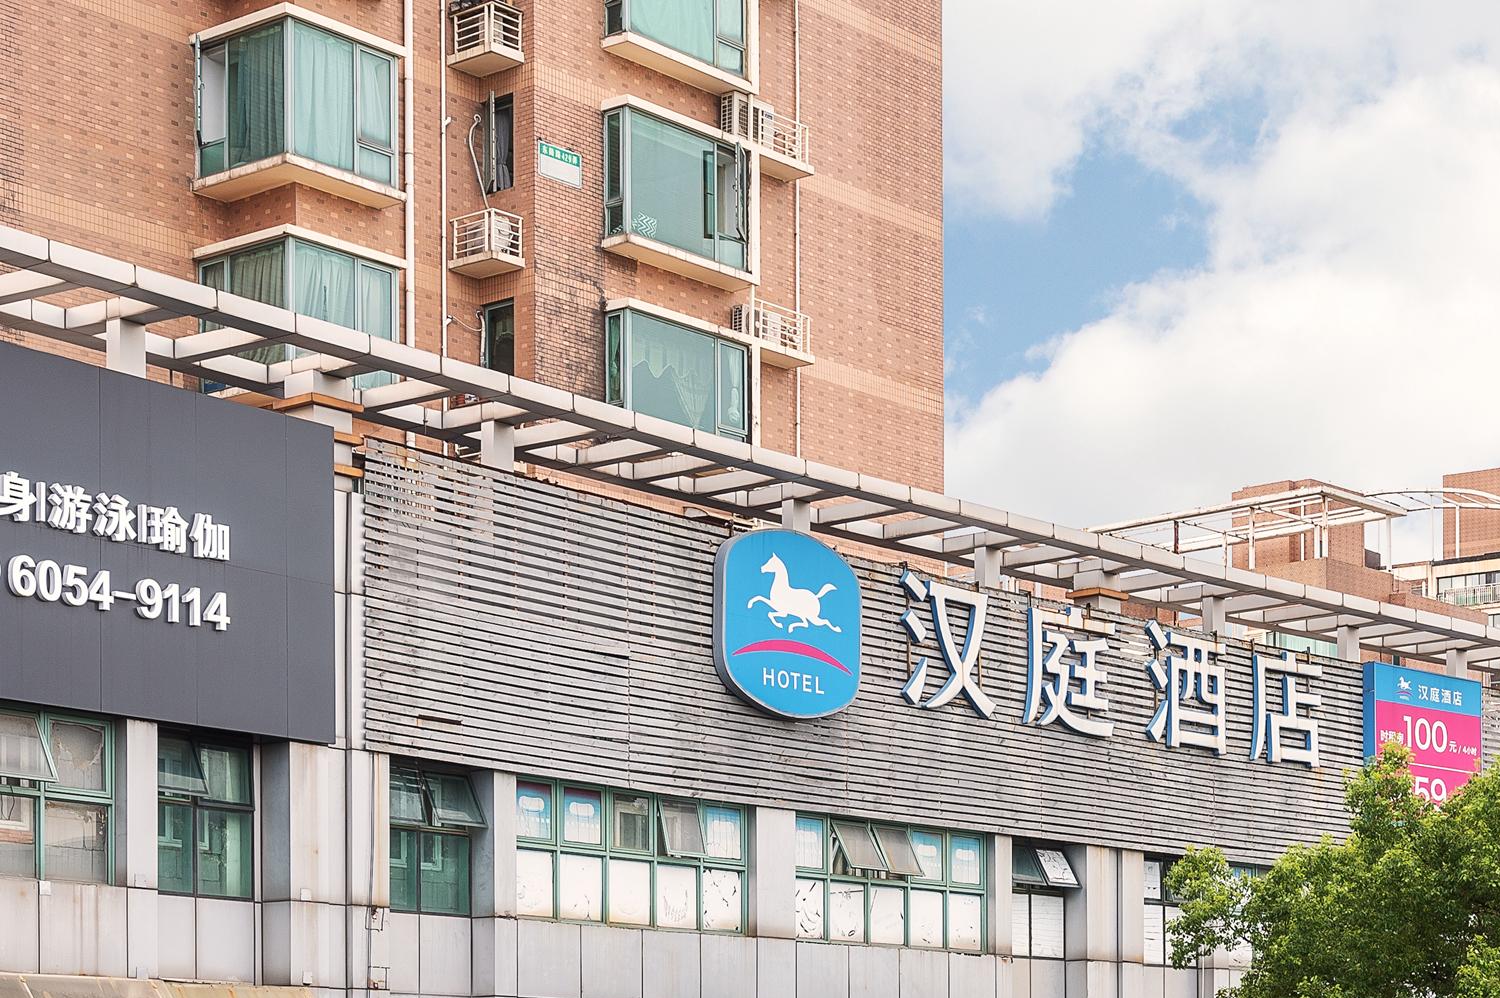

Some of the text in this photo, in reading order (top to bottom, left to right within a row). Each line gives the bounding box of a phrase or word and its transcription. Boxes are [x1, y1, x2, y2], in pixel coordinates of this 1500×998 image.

[8, 555, 230, 631] 6054-9114
[762, 667, 824, 695] HOTEL
[901, 567, 1323, 768] 汉庭酒店
[1418, 684, 1462, 706] 汉庭酒店
[1403, 715, 1448, 753] 100
